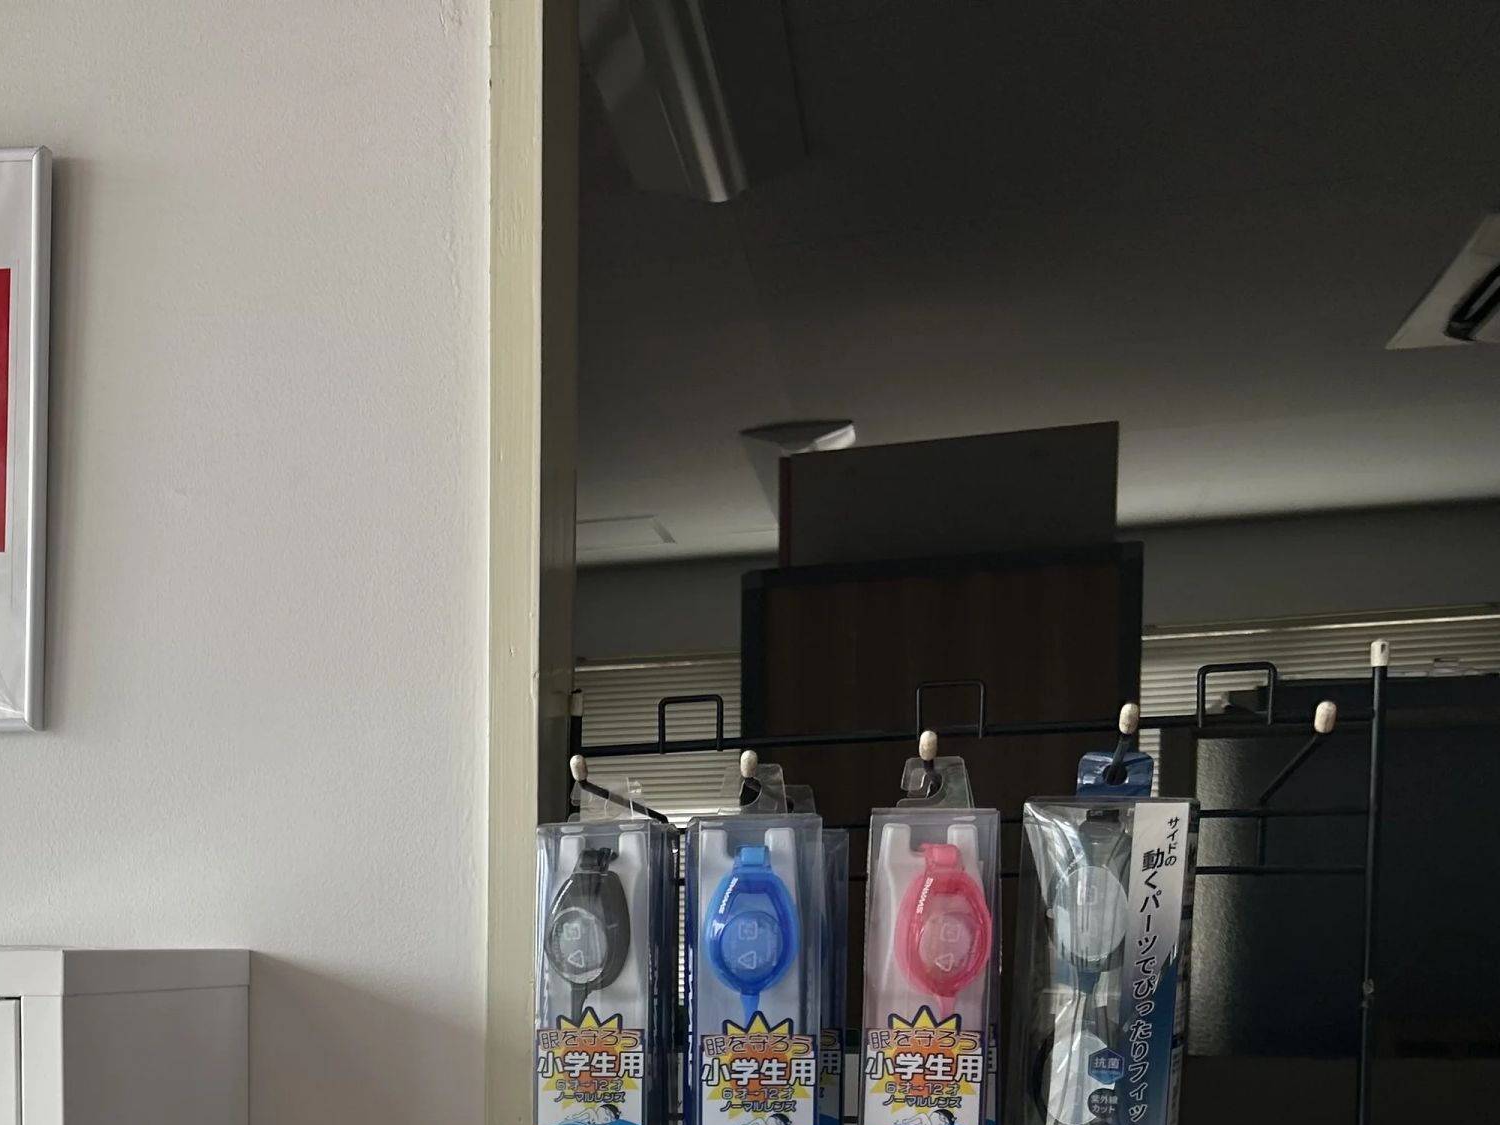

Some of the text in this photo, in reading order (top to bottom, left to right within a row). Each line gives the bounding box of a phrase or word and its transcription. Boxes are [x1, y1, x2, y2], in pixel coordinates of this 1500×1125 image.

[1164, 815, 1181, 867] サイドの
[540, 1029, 640, 1050] 眼を守ろう
[704, 1035, 812, 1057] 眼を守ろう
[870, 1029, 981, 1051] 眼を守ろう
[537, 1051, 645, 1079] 小学生用
[701, 1058, 816, 1086] 小学生用
[865, 1051, 984, 1083] 小学生用
[1094, 1057, 1120, 1069] 抗菌
[554, 1091, 625, 1103] ノーマルレンズ
[720, 1100, 797, 1112] ノーマルレンズ
[882, 1095, 962, 1109] ノーマルレンズ
[1091, 1104, 1116, 1114] カット
